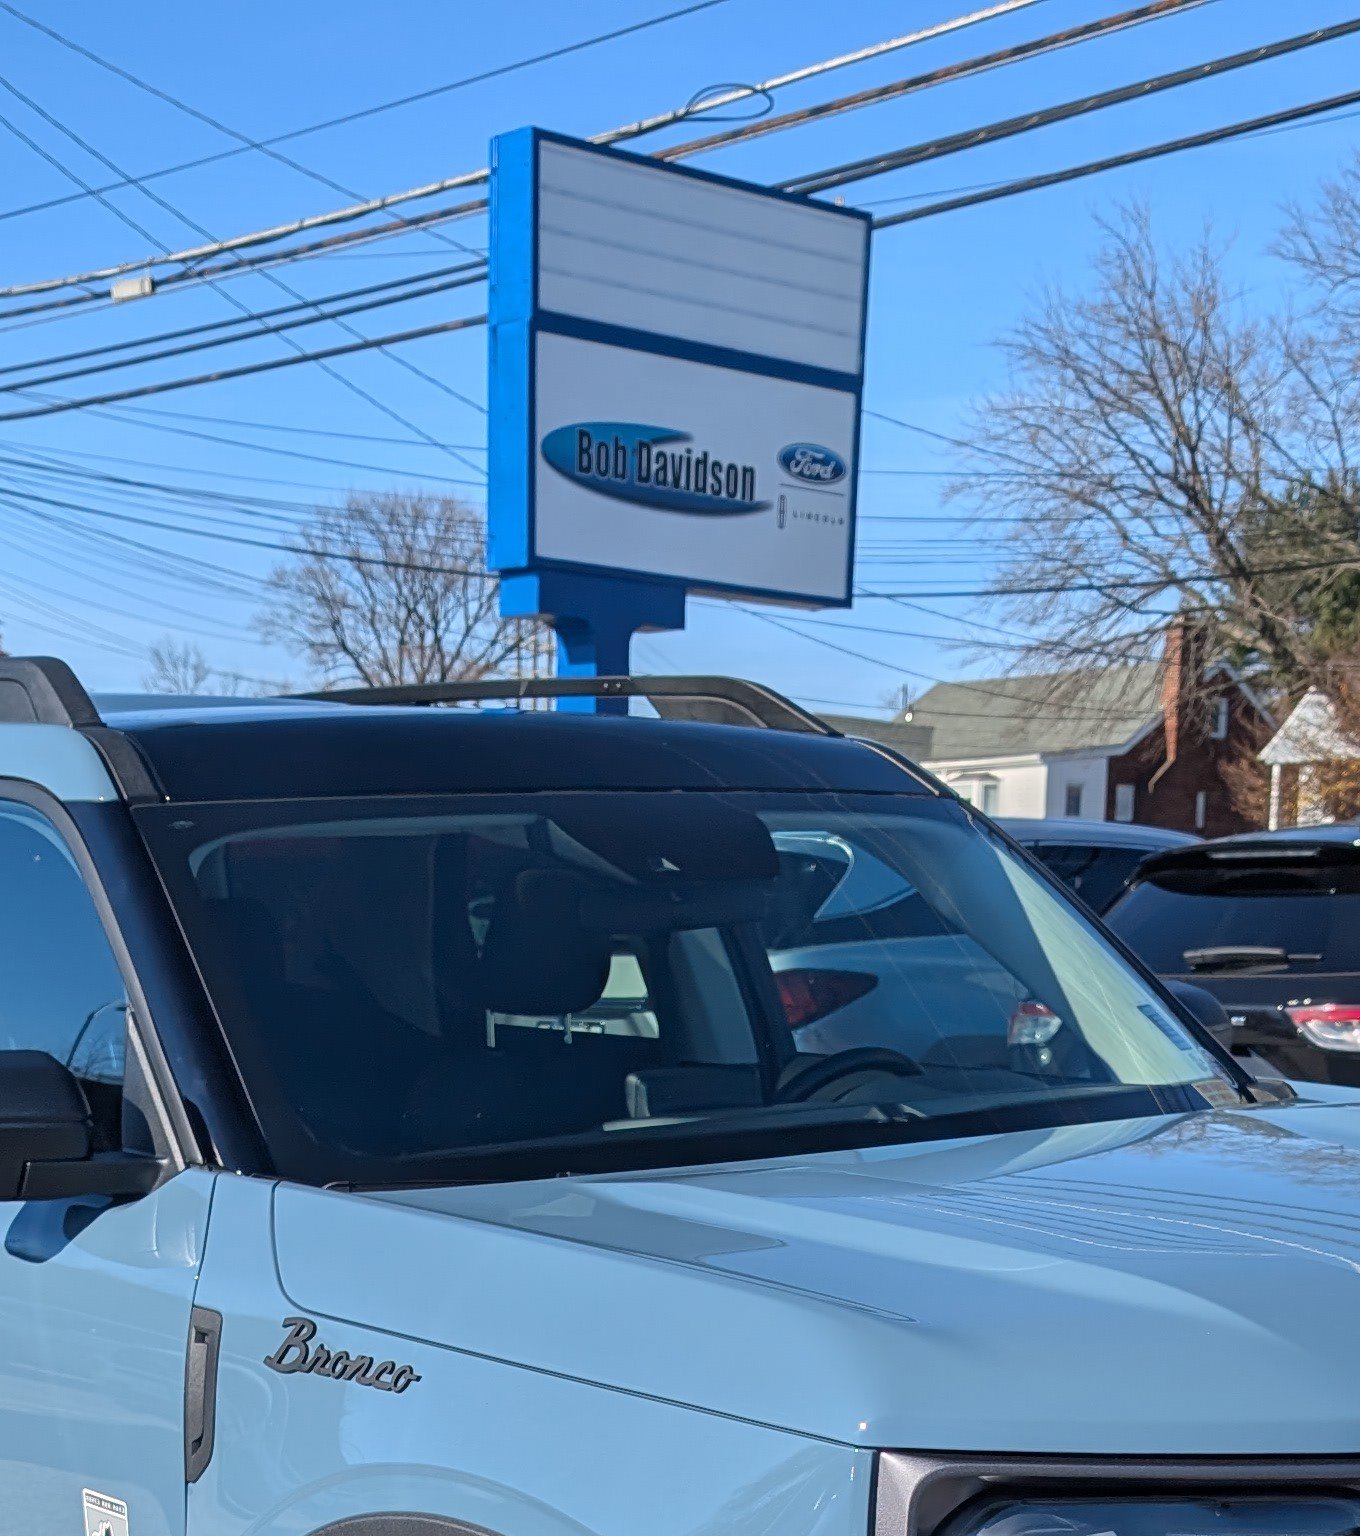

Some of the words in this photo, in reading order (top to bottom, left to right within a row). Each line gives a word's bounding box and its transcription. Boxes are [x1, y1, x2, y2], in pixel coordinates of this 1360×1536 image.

[577, 428, 627, 480] Bob
[636, 439, 756, 502] Davidson
[788, 447, 838, 481] Ford
[263, 1317, 422, 1394] Bronco
